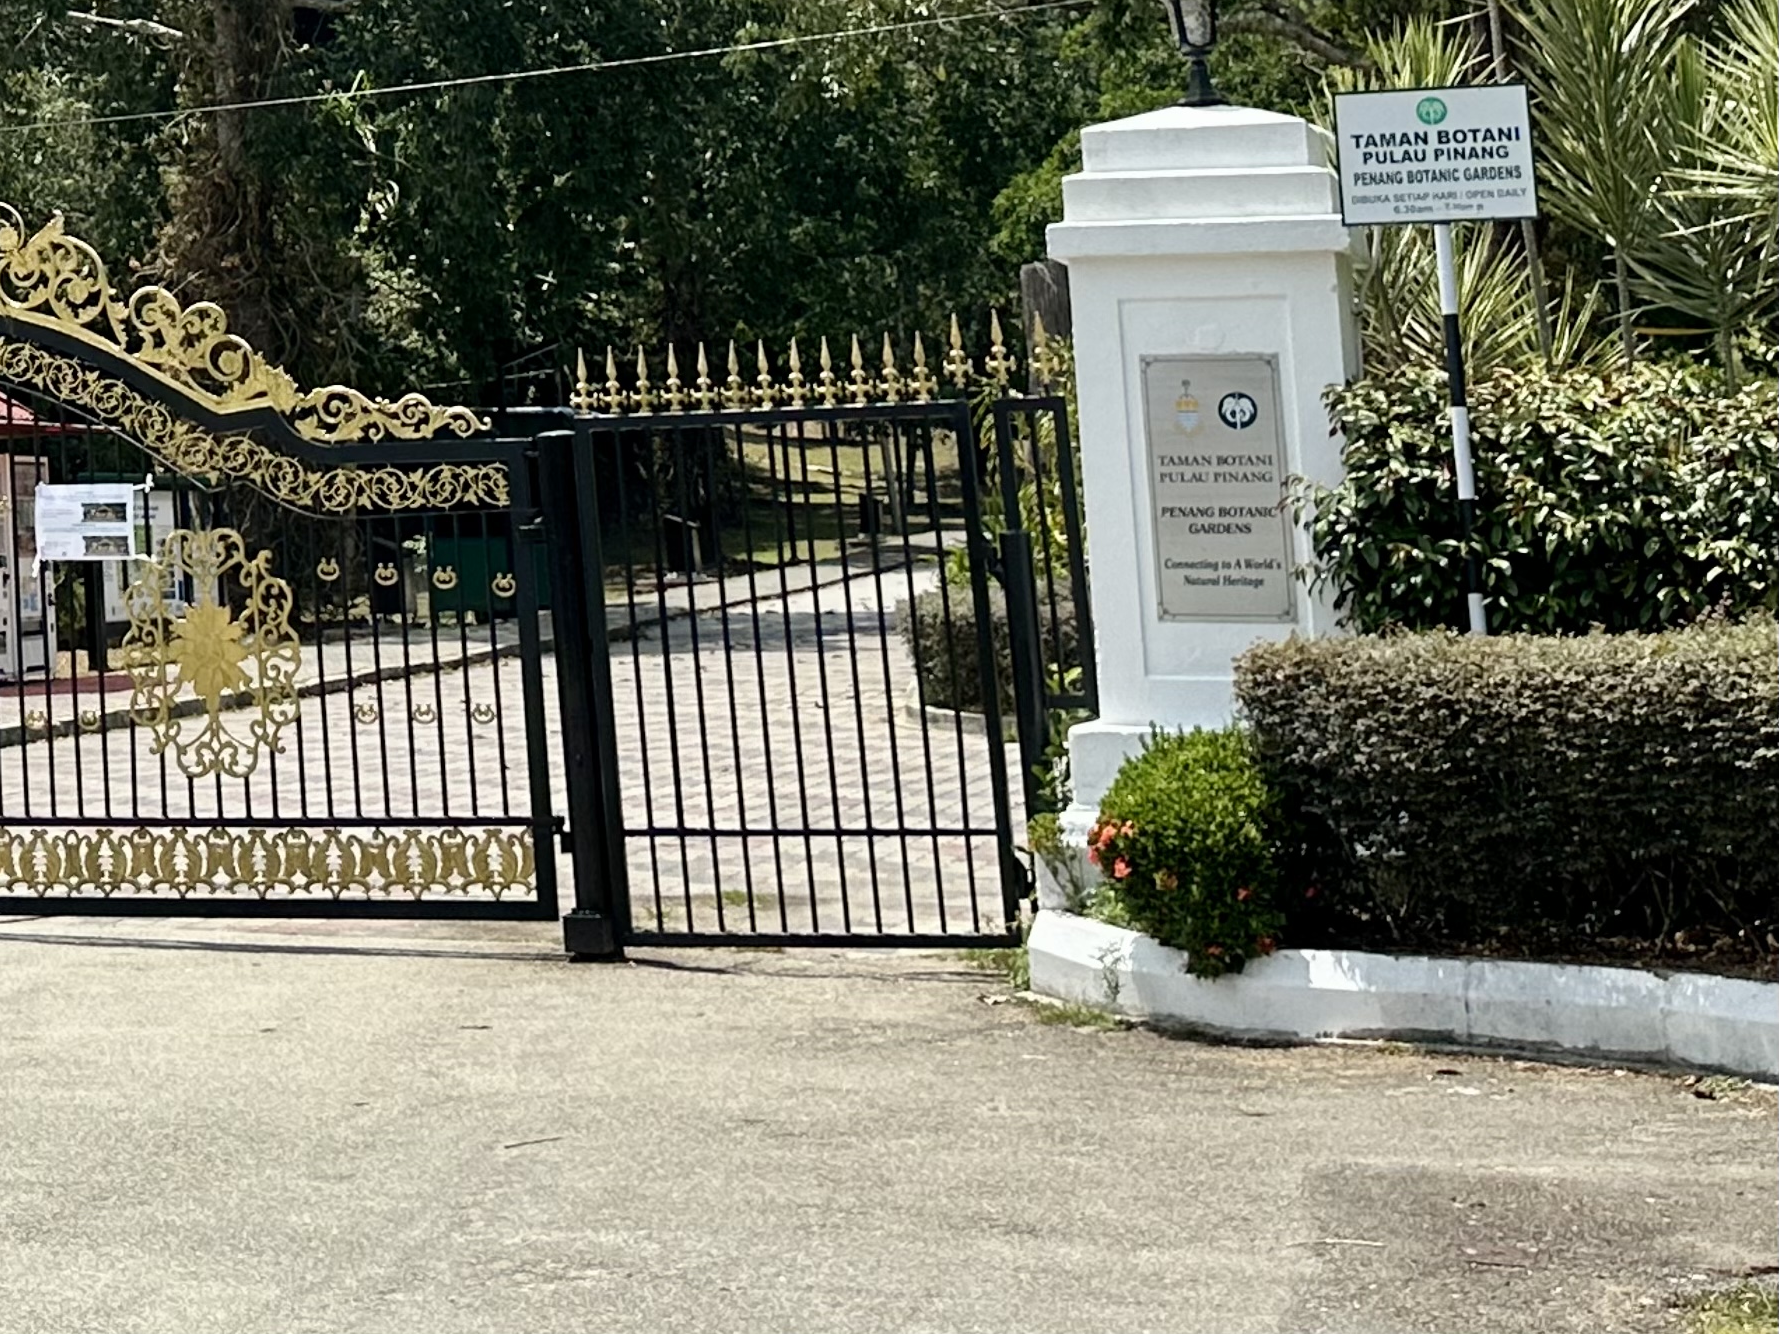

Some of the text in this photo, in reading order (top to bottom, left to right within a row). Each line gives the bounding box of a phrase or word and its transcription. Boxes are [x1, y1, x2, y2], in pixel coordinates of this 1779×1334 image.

[1350, 126, 1521, 149] TAMAN BOTANI
[1362, 145, 1510, 165] PULAU PINANG
[1353, 165, 1523, 187] PENANG BOTANIC GARDENS
[1351, 194, 1391, 205] DIBUKA
[1393, 192, 1430, 203] SETIAP
[1465, 189, 1495, 200] OPEN
[1497, 187, 1527, 198] DAILY
[1157, 454, 1273, 467] TAMAN BOTANI
[1159, 471, 1273, 483] PULAU PINANG
[1161, 506, 1278, 518] PENANG BOTANIC
[1188, 523, 1252, 534] GARDENS
[1164, 557, 1219, 572] Connecting
[1221, 559, 1232, 570] to
[1234, 558, 1242, 570] A
[1183, 574, 1264, 588] Natural Heritage
